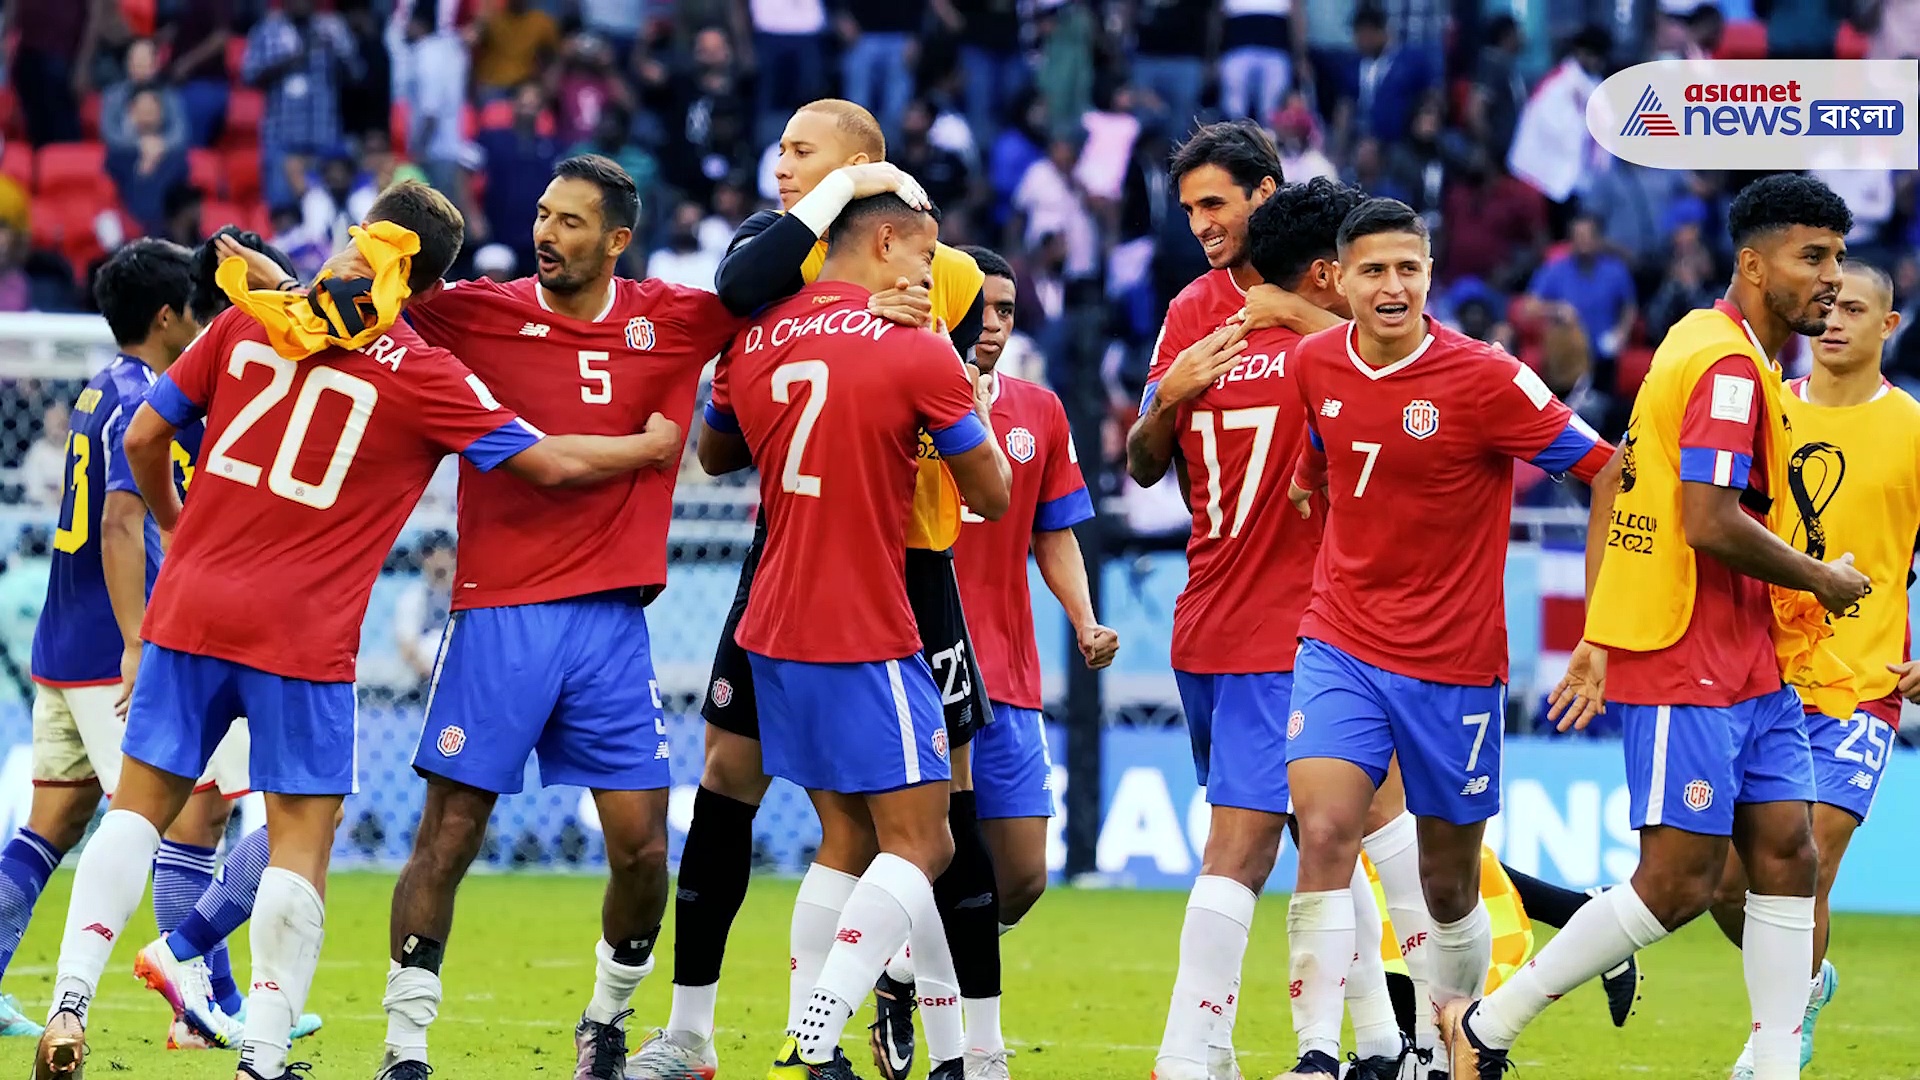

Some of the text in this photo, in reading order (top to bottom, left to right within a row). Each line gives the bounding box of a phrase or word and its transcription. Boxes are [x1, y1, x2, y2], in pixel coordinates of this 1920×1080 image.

[356, 334, 409, 372] RA
[744, 325, 764, 354] D.
[577, 350, 613, 405] 5
[205, 338, 379, 510] 20
[770, 359, 830, 498] 2
[1190, 405, 1281, 540] 17
[1351, 440, 1383, 499] 7
[931, 638, 972, 706] 23
[1462, 711, 1492, 772] 7
[1834, 712, 1890, 772] 25
